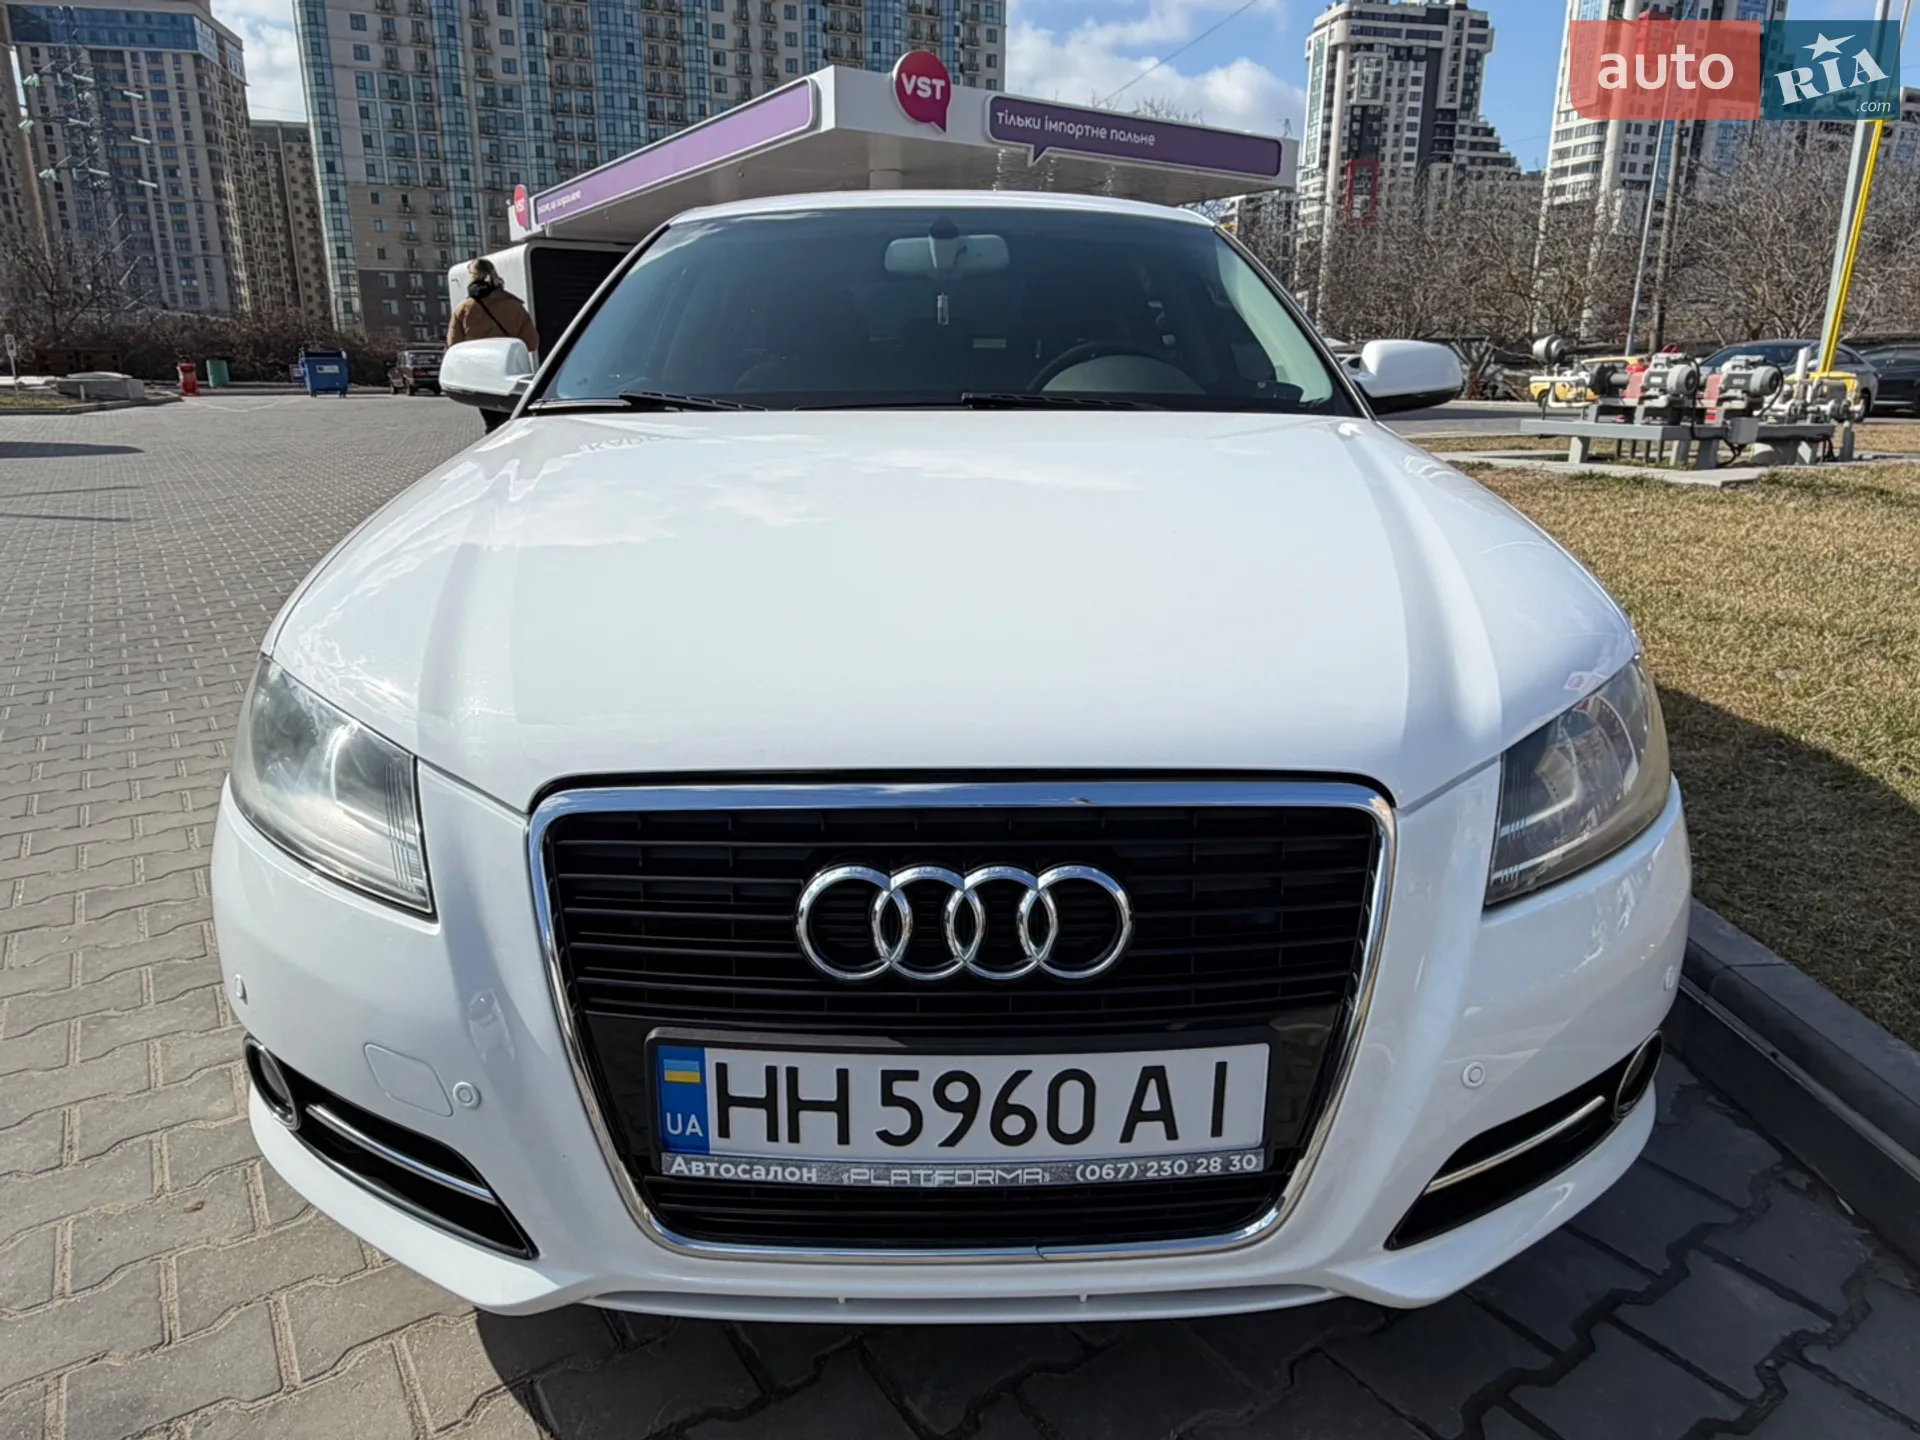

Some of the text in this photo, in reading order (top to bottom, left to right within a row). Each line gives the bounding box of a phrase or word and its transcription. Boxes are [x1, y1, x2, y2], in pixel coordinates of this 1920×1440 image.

[900, 72, 946, 101] VST
[996, 108, 1156, 147] тільки імпортне пальне
[714, 1061, 850, 1146] HH
[875, 1067, 1097, 1148] 5960
[665, 1112, 704, 1138] UA
[670, 1155, 818, 1184] Автосалон
[1075, 1162, 1139, 1183] (067)
[1145, 1159, 1189, 1178] 230
[1194, 1157, 1223, 1175] 28
[1229, 1154, 1257, 1172] 30
